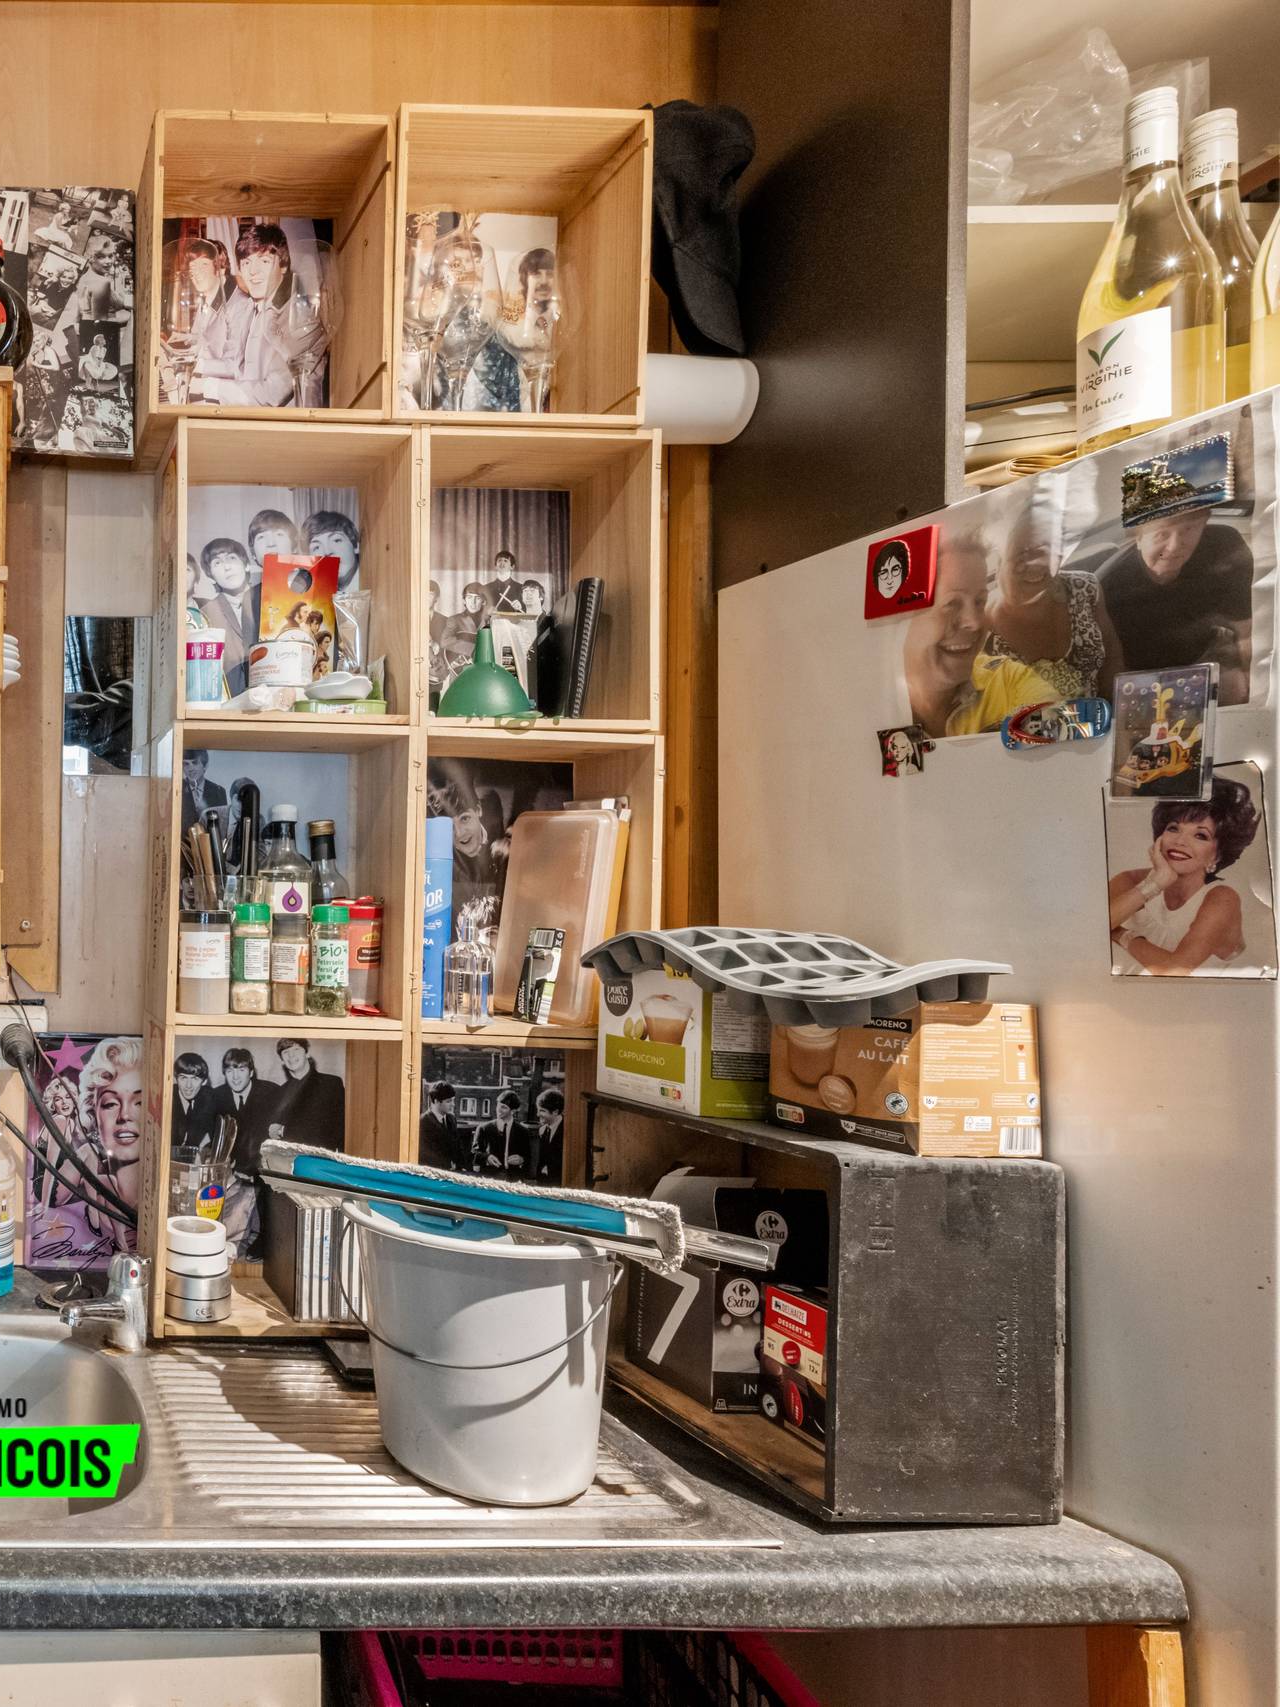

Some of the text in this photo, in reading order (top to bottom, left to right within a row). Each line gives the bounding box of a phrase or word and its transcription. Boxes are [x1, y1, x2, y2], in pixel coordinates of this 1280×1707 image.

[1085, 362, 1120, 380] MAISON
[1080, 365, 1133, 394] VIRGINIE
[874, 1036, 910, 1050] CAFÉ
[618, 1049, 665, 1066] CAPPUCCINO
[857, 1049, 910, 1065] AU LAIT
[759, 1226, 785, 1240] Extra
[726, 1296, 756, 1310] Extra
[781, 1302, 806, 1323] DELHAIZE
